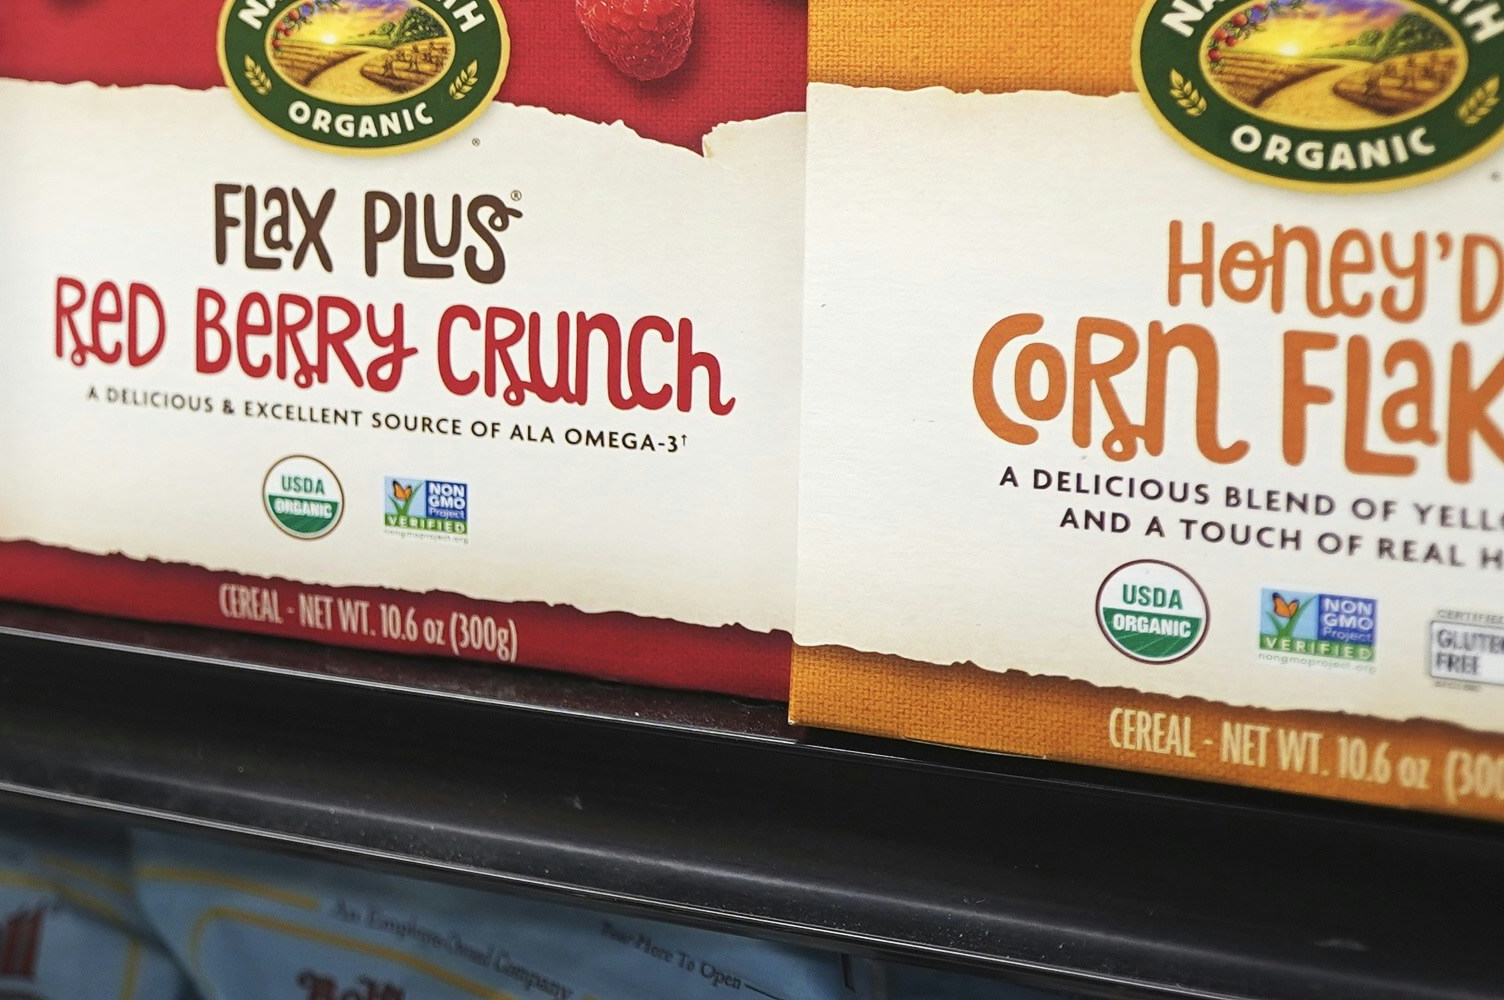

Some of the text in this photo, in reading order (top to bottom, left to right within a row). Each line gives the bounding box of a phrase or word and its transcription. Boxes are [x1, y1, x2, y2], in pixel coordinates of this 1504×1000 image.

[288, 100, 434, 138] ORGANIC
[1231, 124, 1436, 172] ORGANIC
[87, 386, 99, 400] A
[106, 387, 213, 413] DELICIOUS
[223, 399, 235, 414] &
[245, 401, 363, 427] EXCELLENT
[371, 412, 462, 435] SOURCE
[471, 420, 501, 438] OF
[510, 424, 555, 443] ALA
[281, 475, 325, 495] USDA
[429, 482, 465, 497] NON
[275, 498, 333, 519] ORGANIC
[428, 495, 466, 510] GMO
[998, 465, 1504, 533] A DELICIOUS BLEND OF YELL
[387, 515, 466, 534] VERIFIED
[1059, 507, 1133, 534] AND
[1145, 515, 1166, 538] A
[1179, 518, 1303, 551] TOUCH
[1316, 531, 1365, 557] OF
[1377, 537, 1467, 568] REAL
[1122, 582, 1183, 611] USDA
[1324, 598, 1373, 616] NON
[218, 583, 284, 624] CEREAL
[298, 592, 334, 631] NET
[338, 598, 376, 637] WT.
[379, 603, 418, 642] 10.6
[422, 618, 446, 646] oz
[449, 611, 517, 663] (300g)
[1113, 612, 1192, 639] ORGANIC
[1322, 626, 1372, 642] Project
[1323, 612, 1374, 631] GMO
[1266, 637, 1372, 661] VERIFIED
[1437, 652, 1479, 676] FREE
[1108, 707, 1196, 758] CEREAL
[1220, 721, 1271, 768] NET
[1277, 729, 1329, 778] WT.
[1336, 736, 1392, 785] 10.6
[1398, 756, 1430, 790] oz
[677, 952, 696, 971] To
[700, 960, 742, 989] Open
